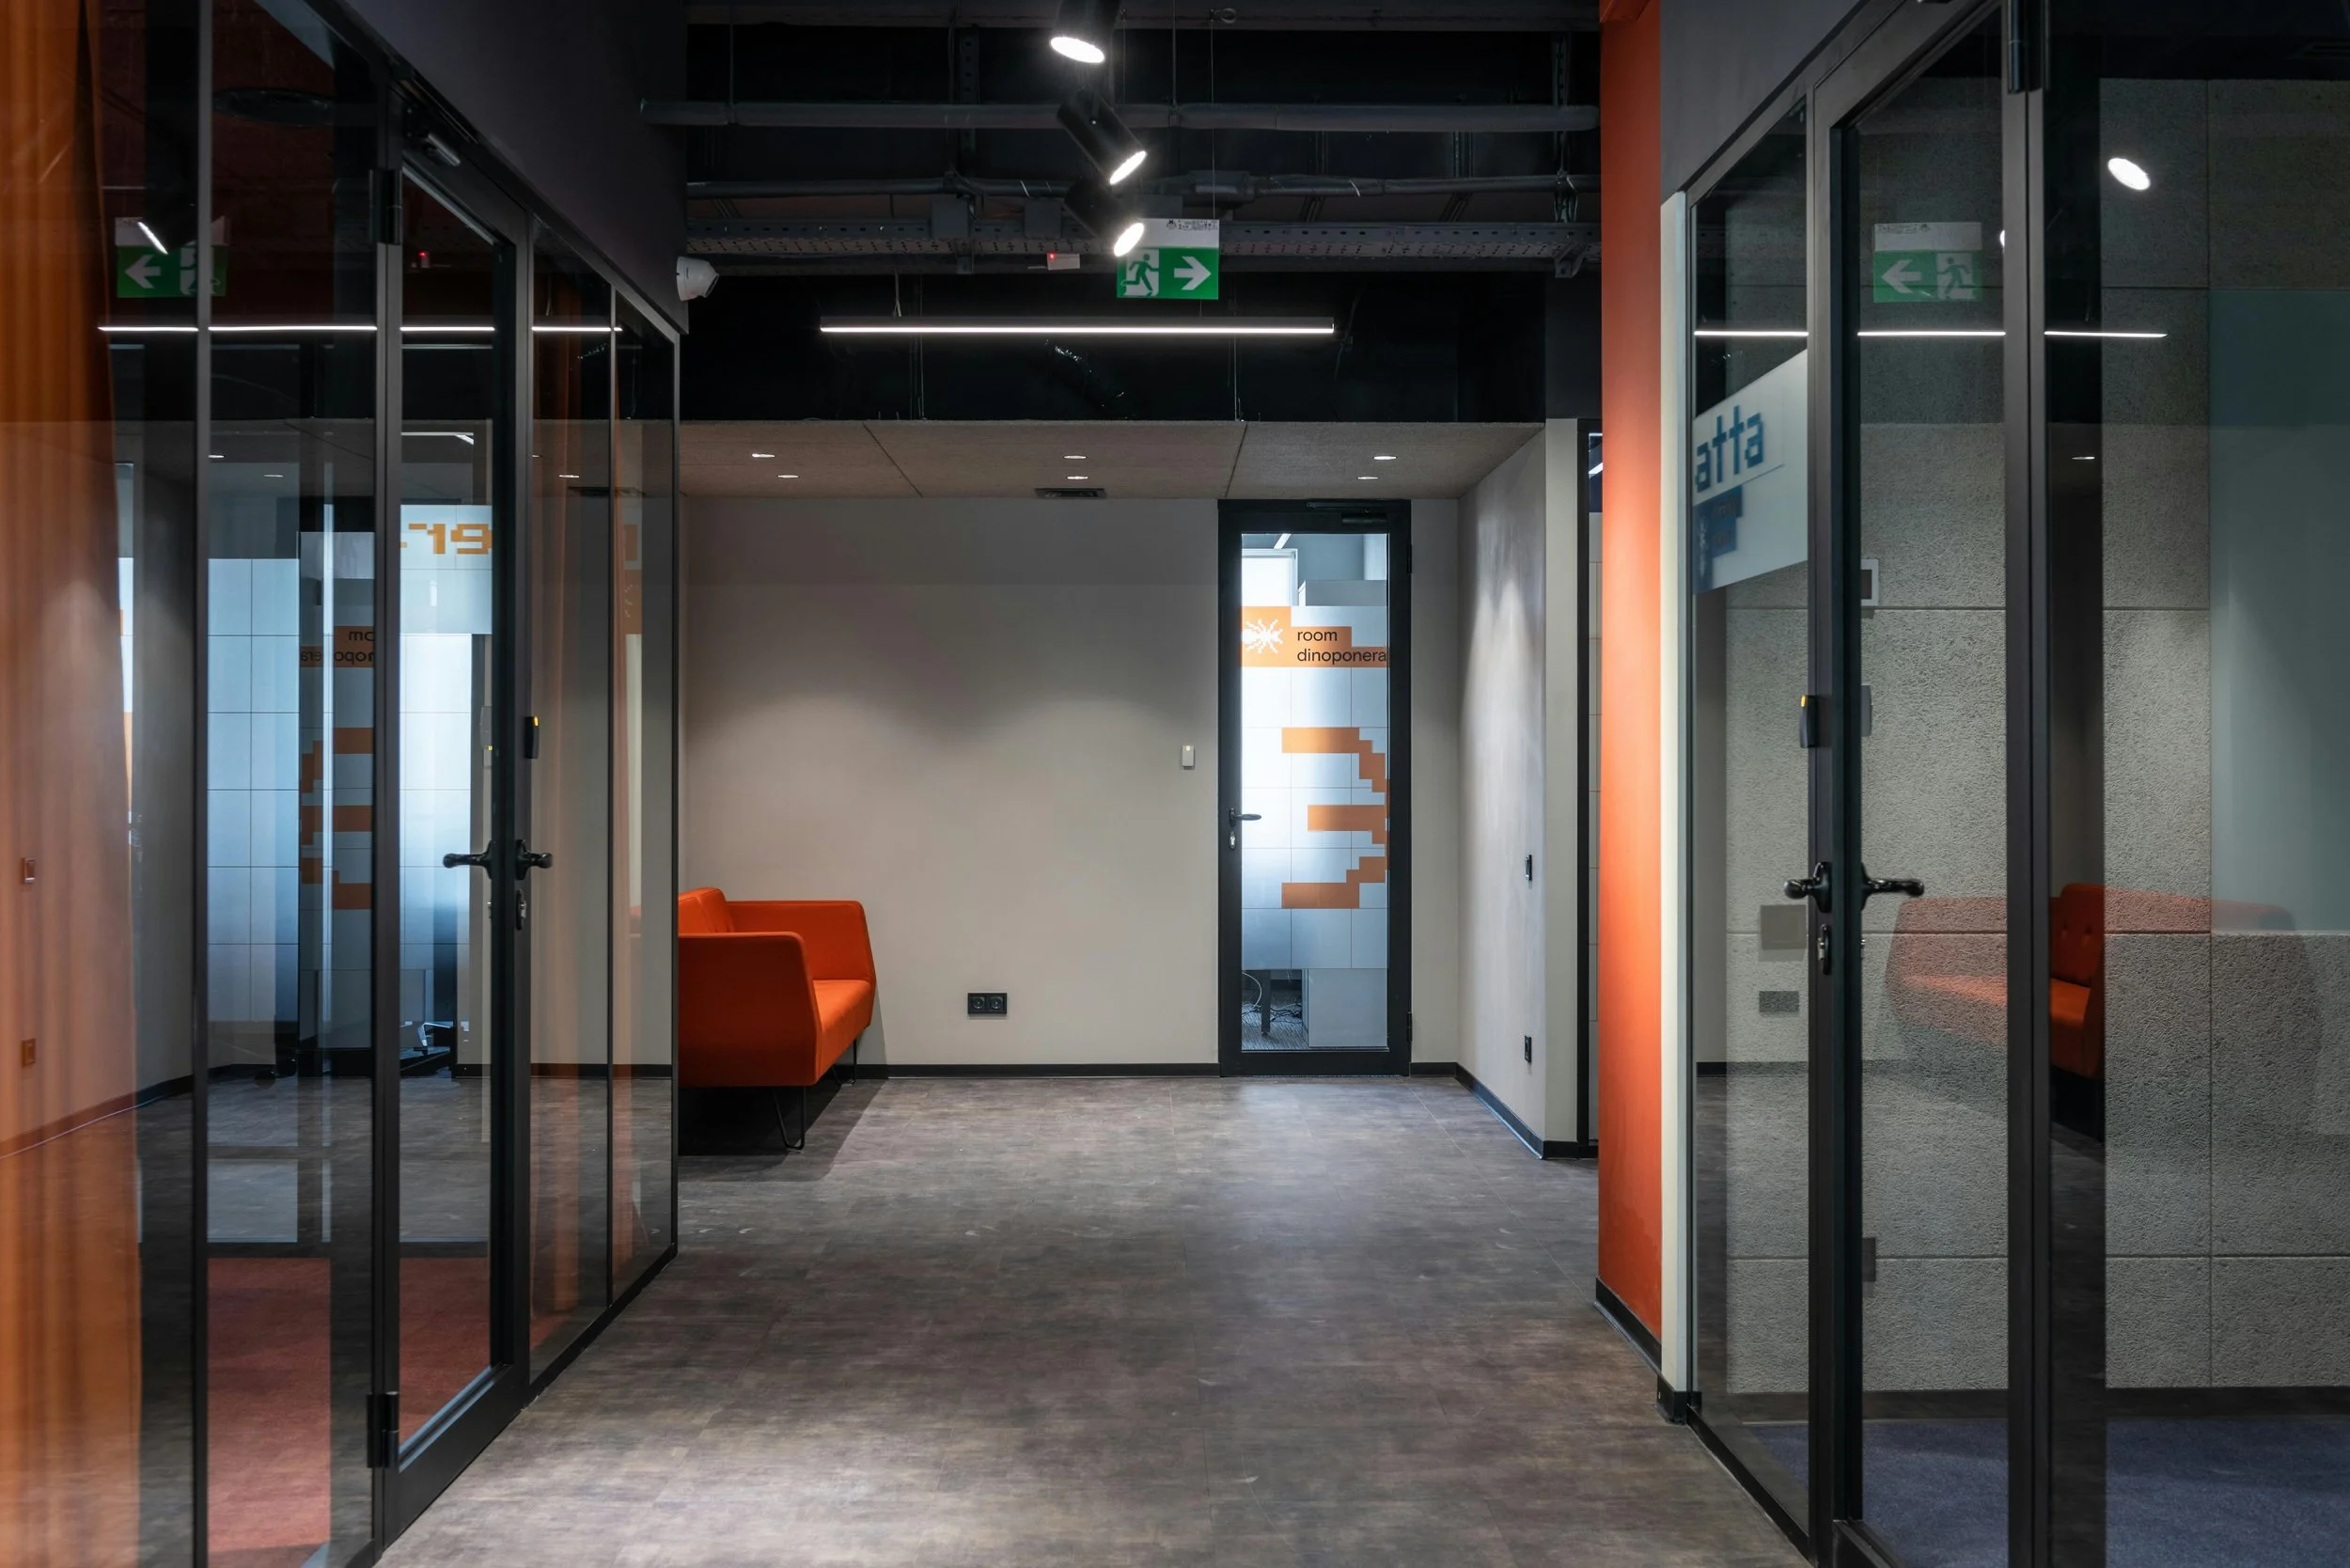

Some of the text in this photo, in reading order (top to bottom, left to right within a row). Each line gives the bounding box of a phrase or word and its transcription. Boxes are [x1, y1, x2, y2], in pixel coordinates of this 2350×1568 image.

[1695, 405, 1763, 493] atta
[1297, 631, 1338, 641] room
[1297, 649, 1386, 665] dinoponera
